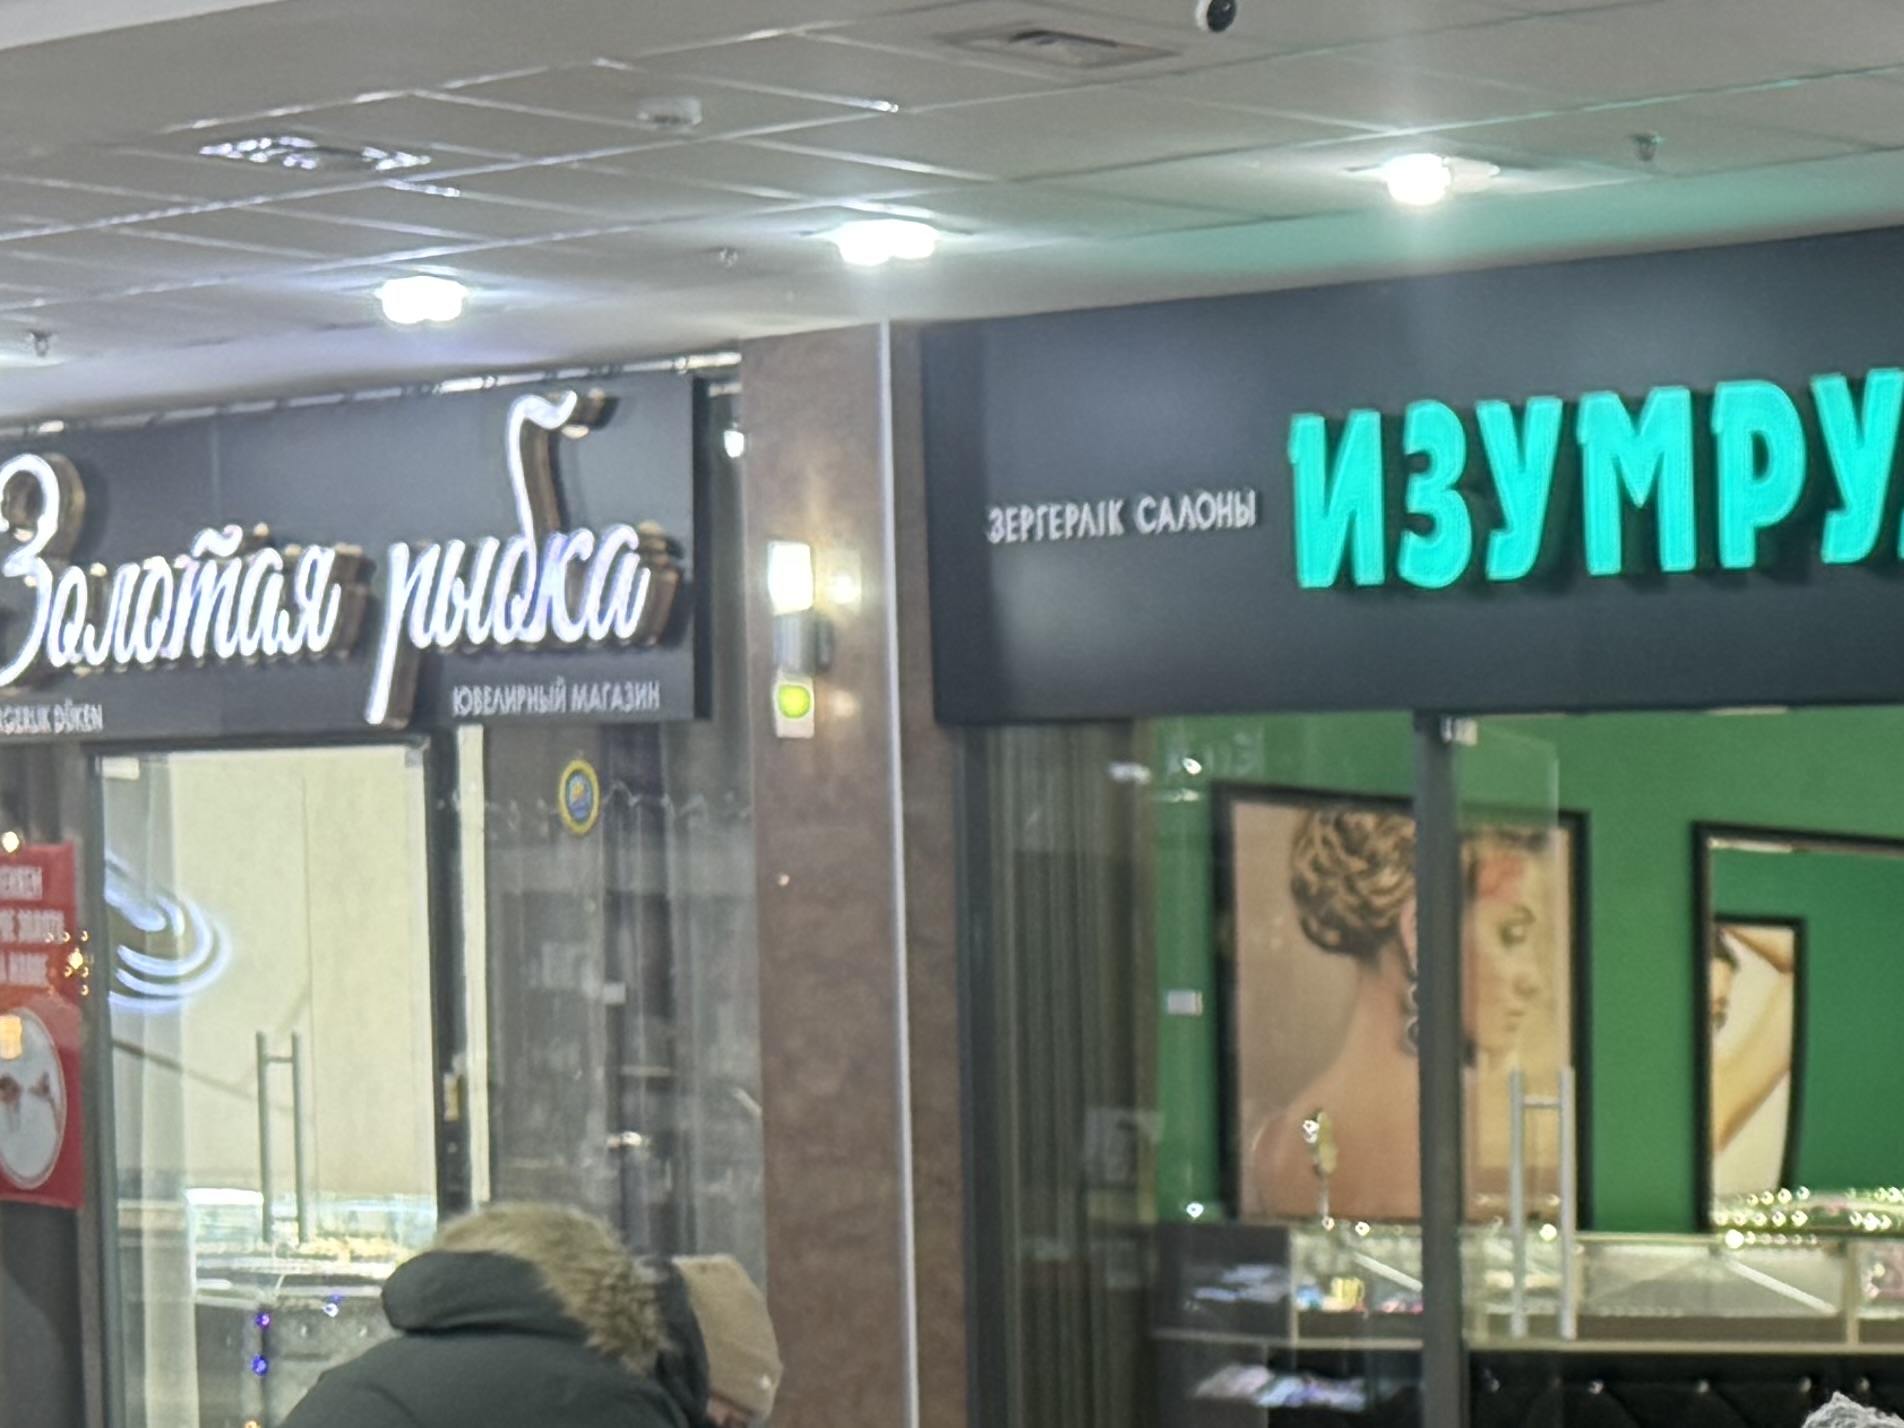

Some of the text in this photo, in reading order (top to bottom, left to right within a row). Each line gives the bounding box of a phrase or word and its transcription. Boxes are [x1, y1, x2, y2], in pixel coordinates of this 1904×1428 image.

[986, 488, 1256, 544] ЗЕРГЕРЛІК САЛОНЫ
[0, 389, 653, 725] Золотая рыбка
[452, 676, 660, 716] ЮВЕЛИРНЫЙ МАГАЗИН
